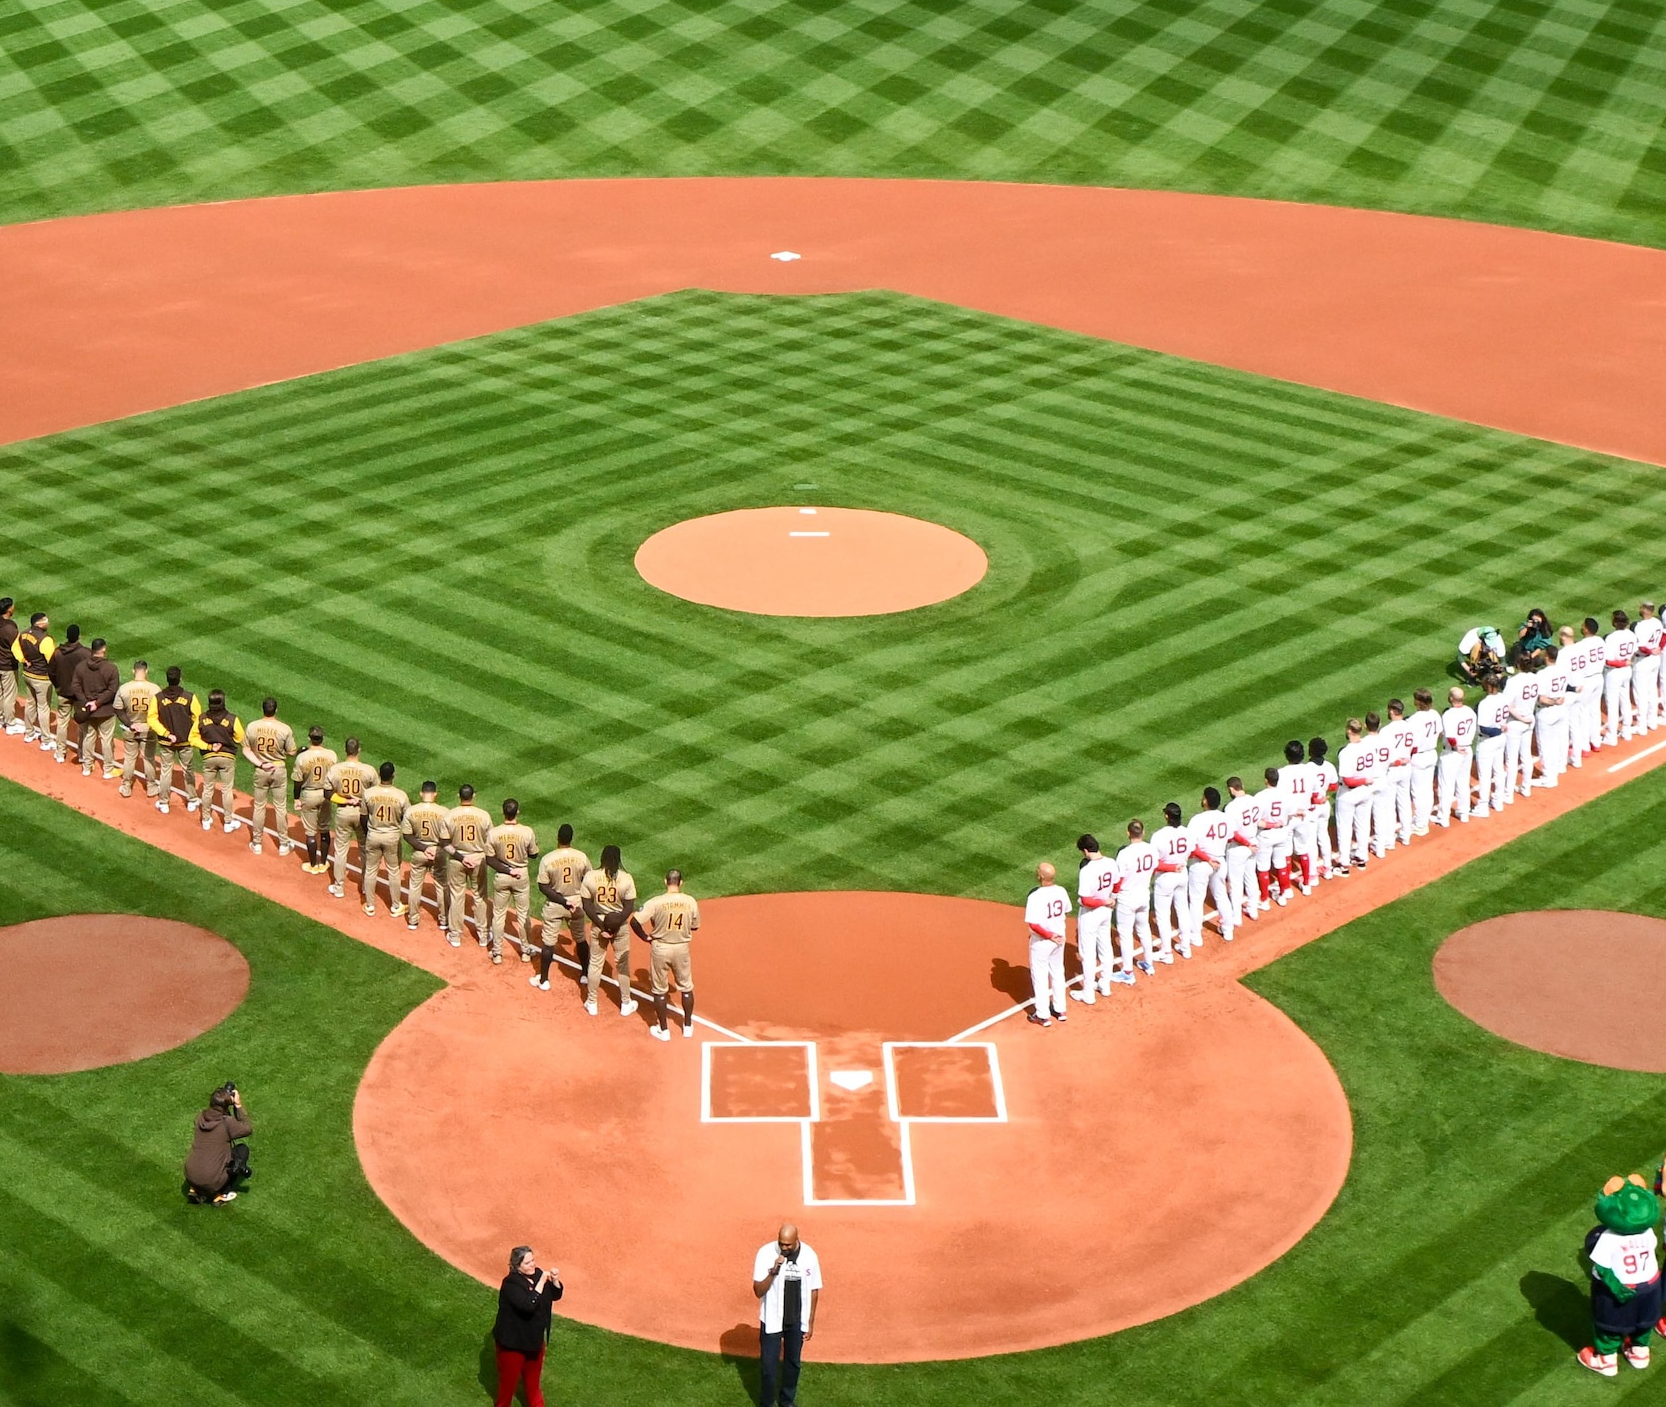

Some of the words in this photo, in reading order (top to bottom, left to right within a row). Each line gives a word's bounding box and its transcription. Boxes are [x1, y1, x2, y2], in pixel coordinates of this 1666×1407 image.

[1570, 655, 1586, 672] 56
[1551, 676, 1567, 693] 57
[131, 697, 149, 713] 25
[1457, 718, 1474, 736] 67
[257, 736, 276, 753] 22
[1395, 732, 1414, 748] 76
[1356, 755, 1374, 772] 89
[341, 778, 361, 795] 30
[1292, 777, 1306, 794] 11
[376, 805, 392, 822] 41
[1241, 806, 1260, 827] 52
[1270, 801, 1282, 817] 5
[460, 824, 476, 842] 13
[1206, 822, 1228, 841] 40
[1169, 837, 1188, 856] 16
[1136, 854, 1153, 873] 10
[1097, 872, 1113, 892] 19
[596, 885, 618, 904] 23
[1046, 900, 1064, 920] 13
[667, 912, 684, 930] 14
[1623, 1250, 1651, 1275] 97
